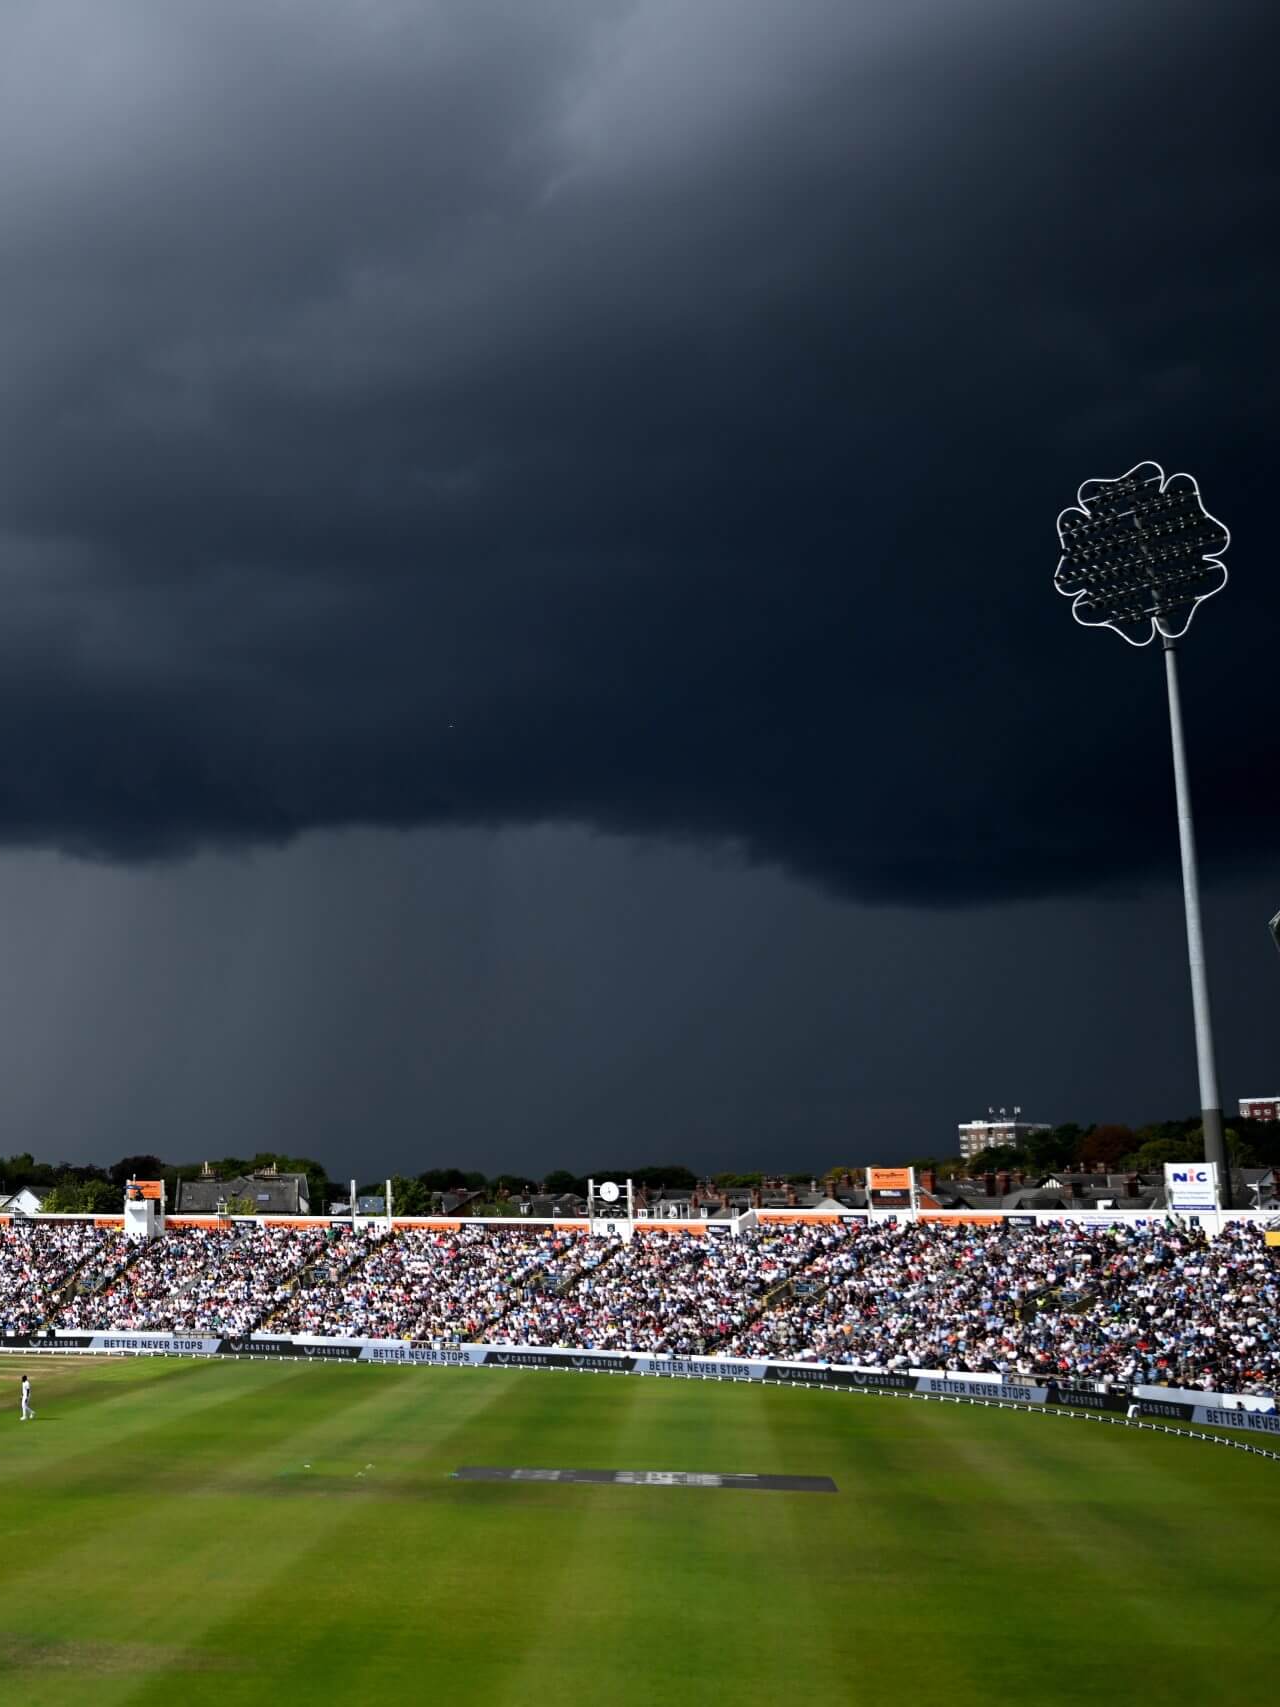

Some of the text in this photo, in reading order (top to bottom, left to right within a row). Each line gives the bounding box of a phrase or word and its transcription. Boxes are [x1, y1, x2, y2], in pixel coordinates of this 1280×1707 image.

[42, 1339, 78, 1347] CASTORE
[103, 1340, 203, 1350] BETTER NEVER STOPS
[244, 1343, 280, 1352] CASTORE
[373, 1349, 470, 1361] BETTER NEVER STOPS
[585, 1358, 623, 1367] CASTORE
[649, 1361, 750, 1376] BETTER NEVER STOPS
[930, 1380, 1032, 1400] BETTER NEVER STOPS
[1206, 1409, 1245, 1427] BETTER
